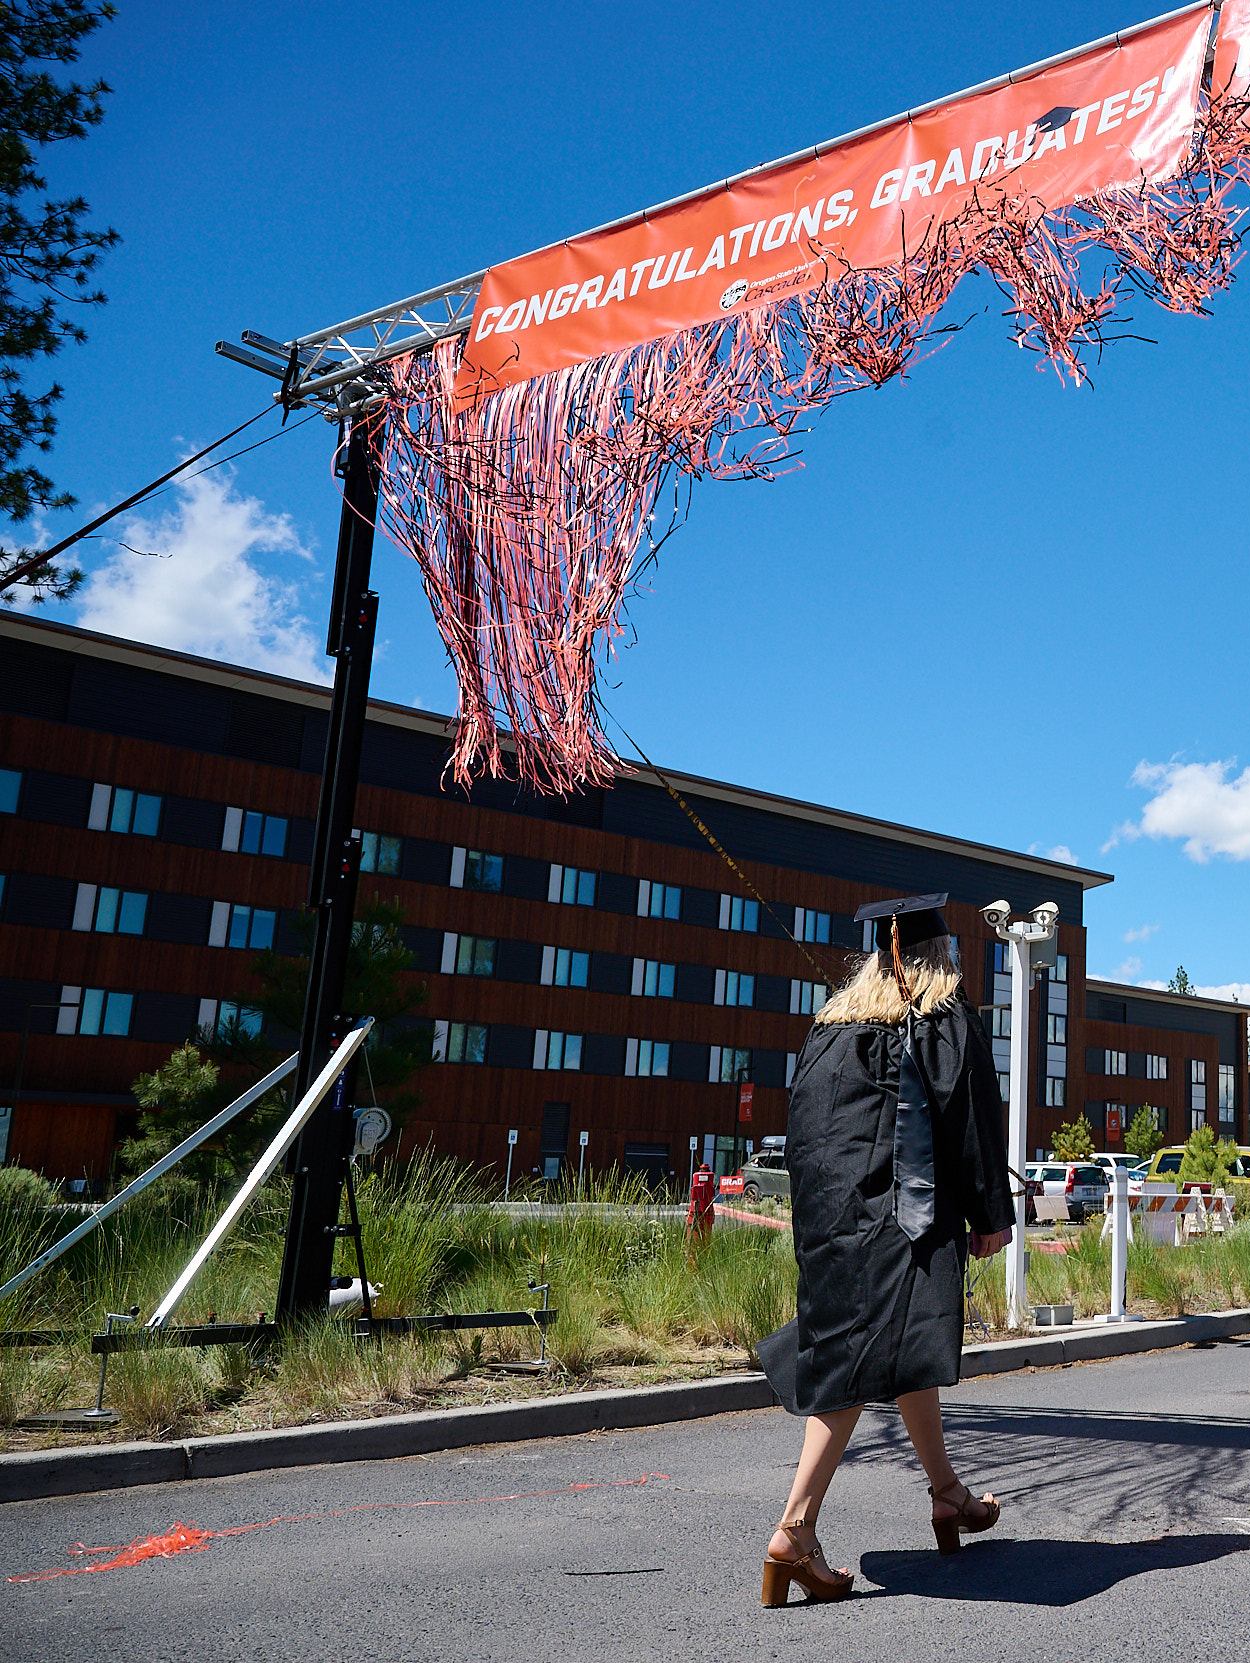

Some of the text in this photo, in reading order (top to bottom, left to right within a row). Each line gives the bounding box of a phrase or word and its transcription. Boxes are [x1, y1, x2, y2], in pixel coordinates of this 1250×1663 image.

[474, 66, 1176, 342] CONGRATULATIONS, GRADUATES!
[750, 275, 776, 289] Oregon
[776, 267, 794, 280] State
